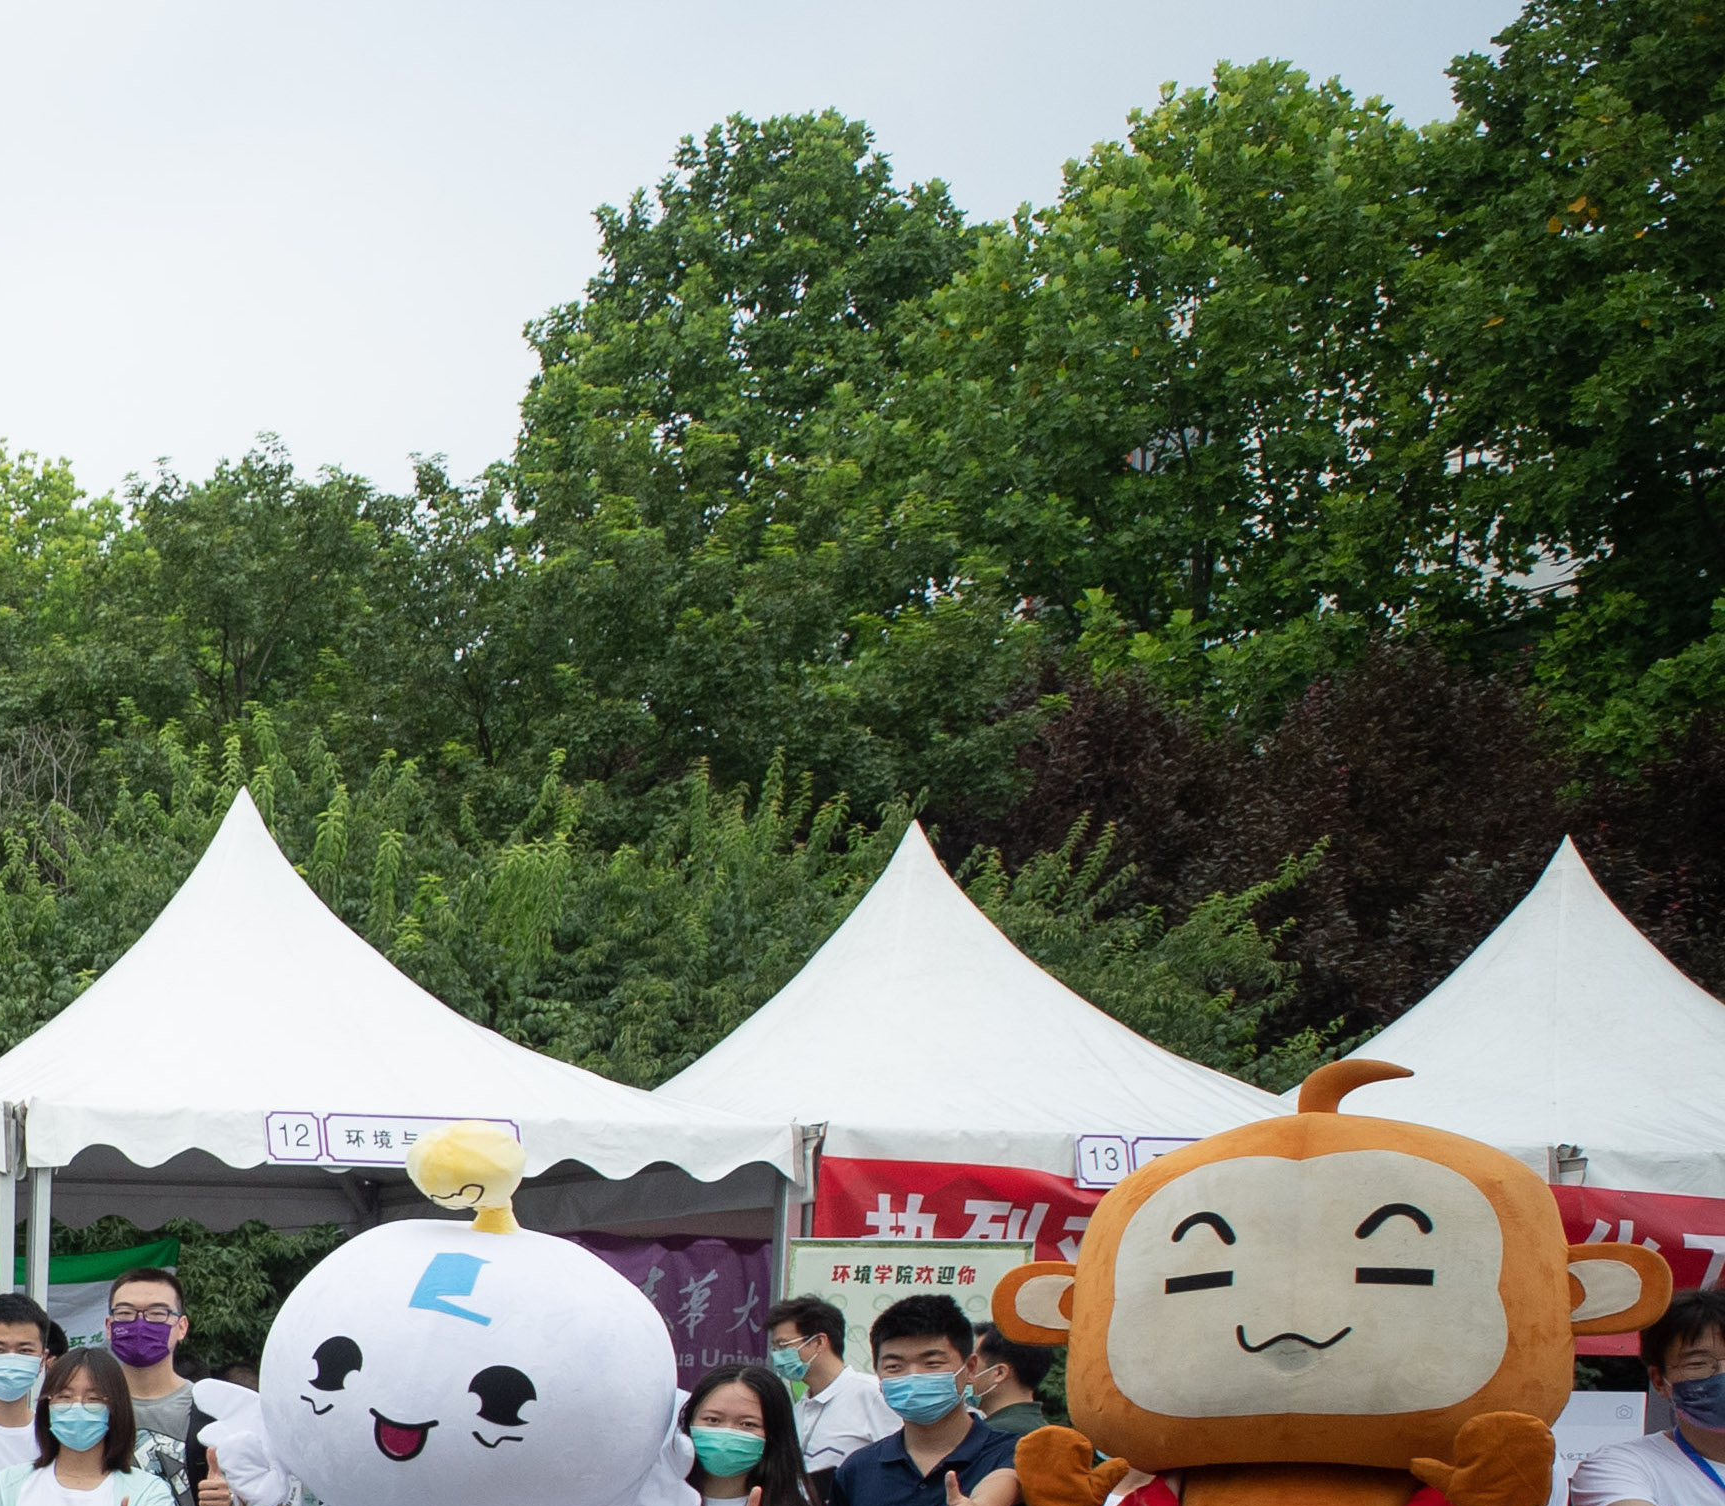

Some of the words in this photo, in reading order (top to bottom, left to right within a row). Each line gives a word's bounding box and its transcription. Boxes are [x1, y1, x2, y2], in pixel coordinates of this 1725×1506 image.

[278, 1122, 310, 1148] 12
[1089, 1146, 1119, 1171] 13
[831, 1264, 977, 1286] 环境学院欢迎你
